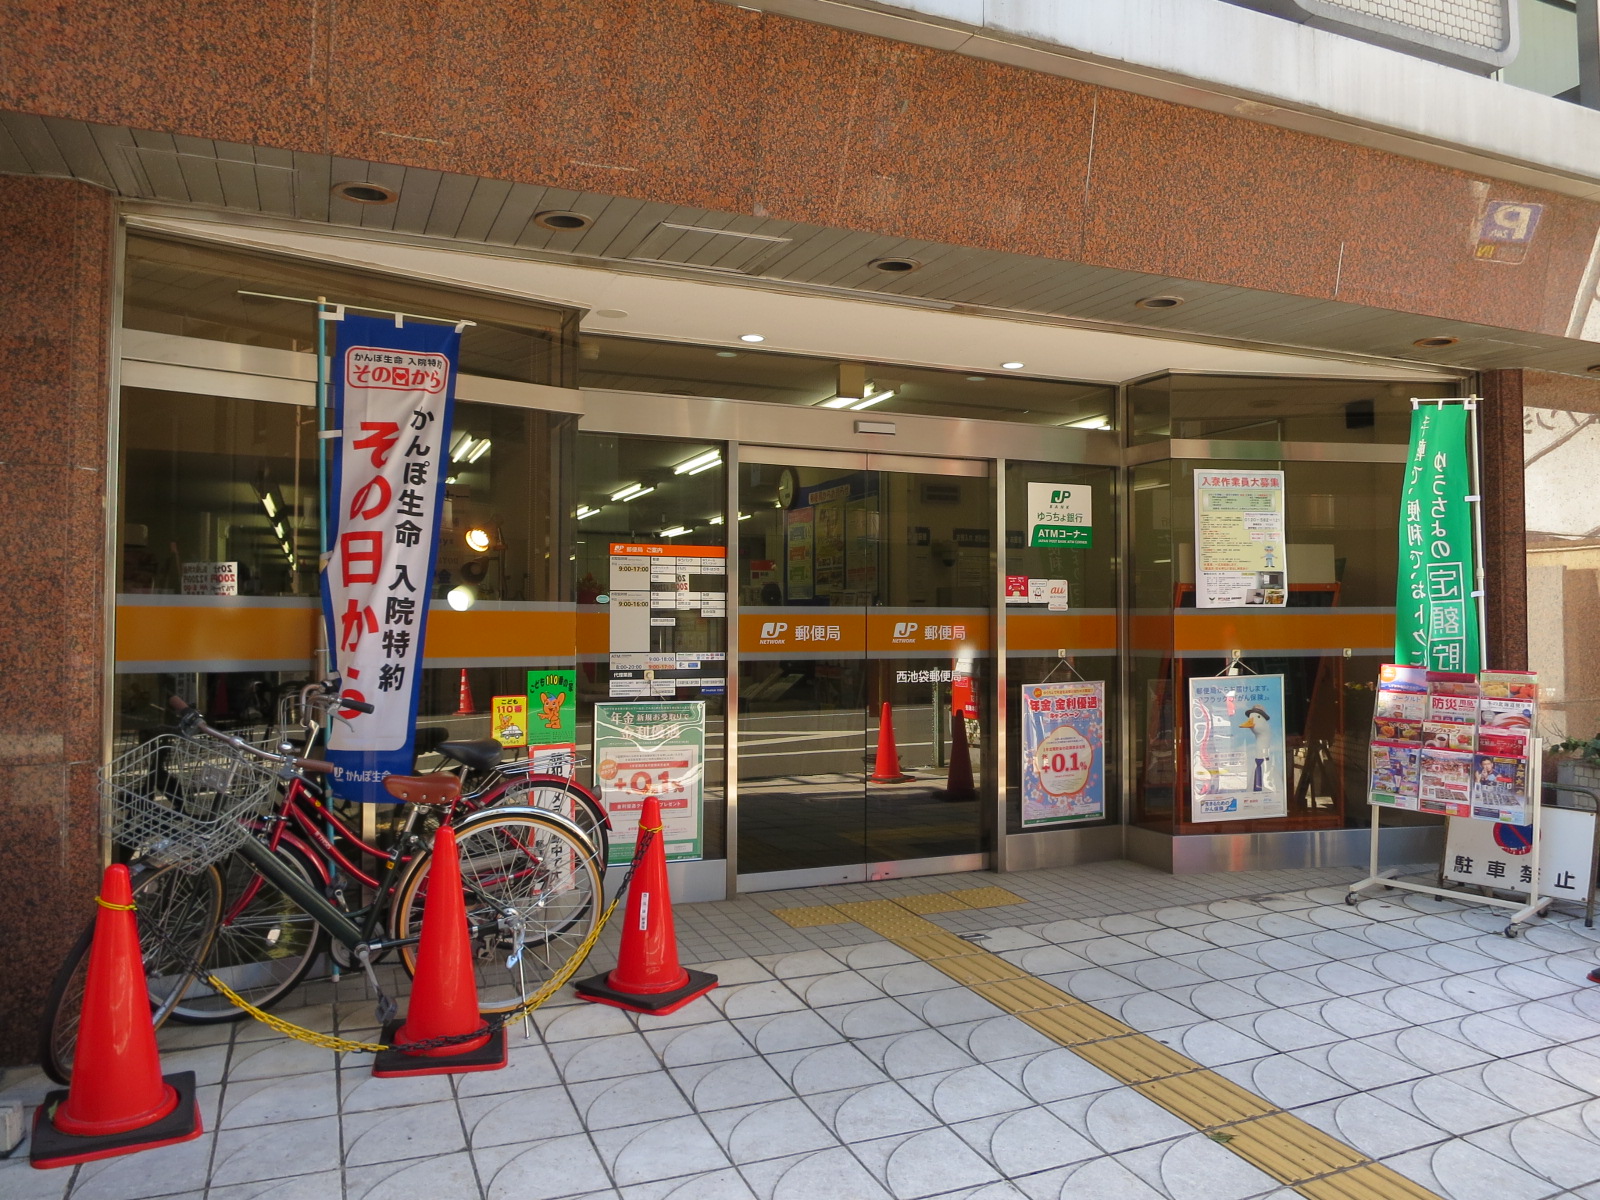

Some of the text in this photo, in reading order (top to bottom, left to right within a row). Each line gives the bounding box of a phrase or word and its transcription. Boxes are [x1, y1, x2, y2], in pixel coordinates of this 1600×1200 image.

[354, 352, 403, 364] かんぽ生命
[1037, 512, 1084, 523] ゆうちょ銀行
[1038, 529, 1088, 539] ATMコーナー
[378, 405, 435, 692] かんぽ生命 入院特約
[337, 421, 400, 720] その日から
[795, 625, 841, 641] 郵便局
[924, 625, 966, 641] 郵便局
[896, 670, 962, 684] 西池袋郵便局
[1432, 697, 1457, 710] 防災
[611, 711, 635, 725] 年金
